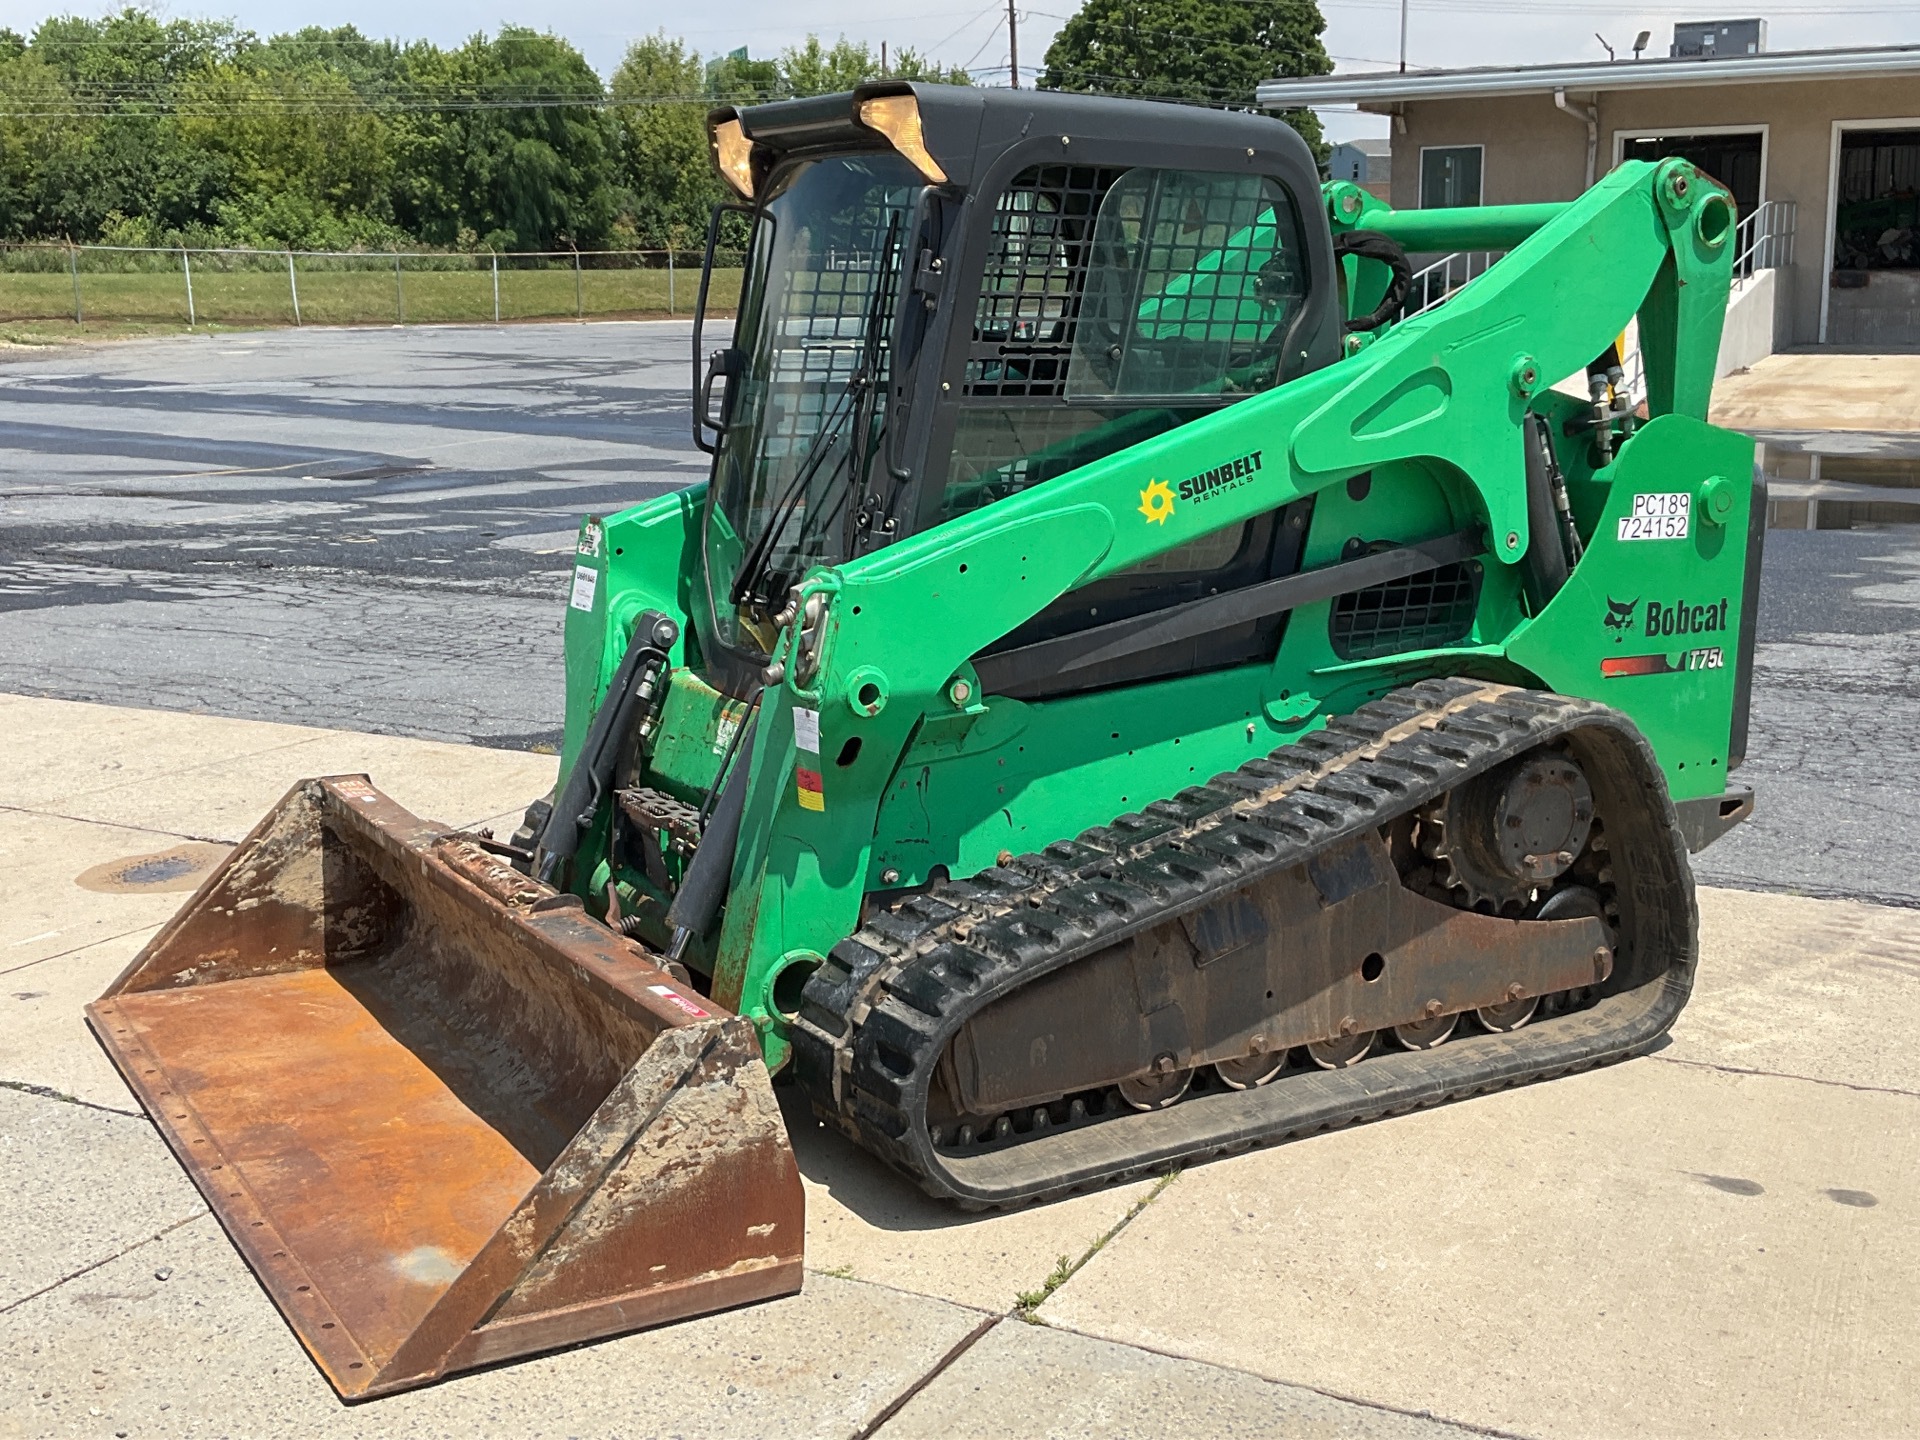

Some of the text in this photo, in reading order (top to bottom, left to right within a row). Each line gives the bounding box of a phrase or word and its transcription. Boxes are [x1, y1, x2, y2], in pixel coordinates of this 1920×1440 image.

[1179, 451, 1262, 500] SUNBELT
[1194, 475, 1253, 505] RENTALS
[1635, 494, 1689, 515] PC189
[1621, 517, 1686, 538] 724152
[1646, 598, 1728, 637] Bobcat
